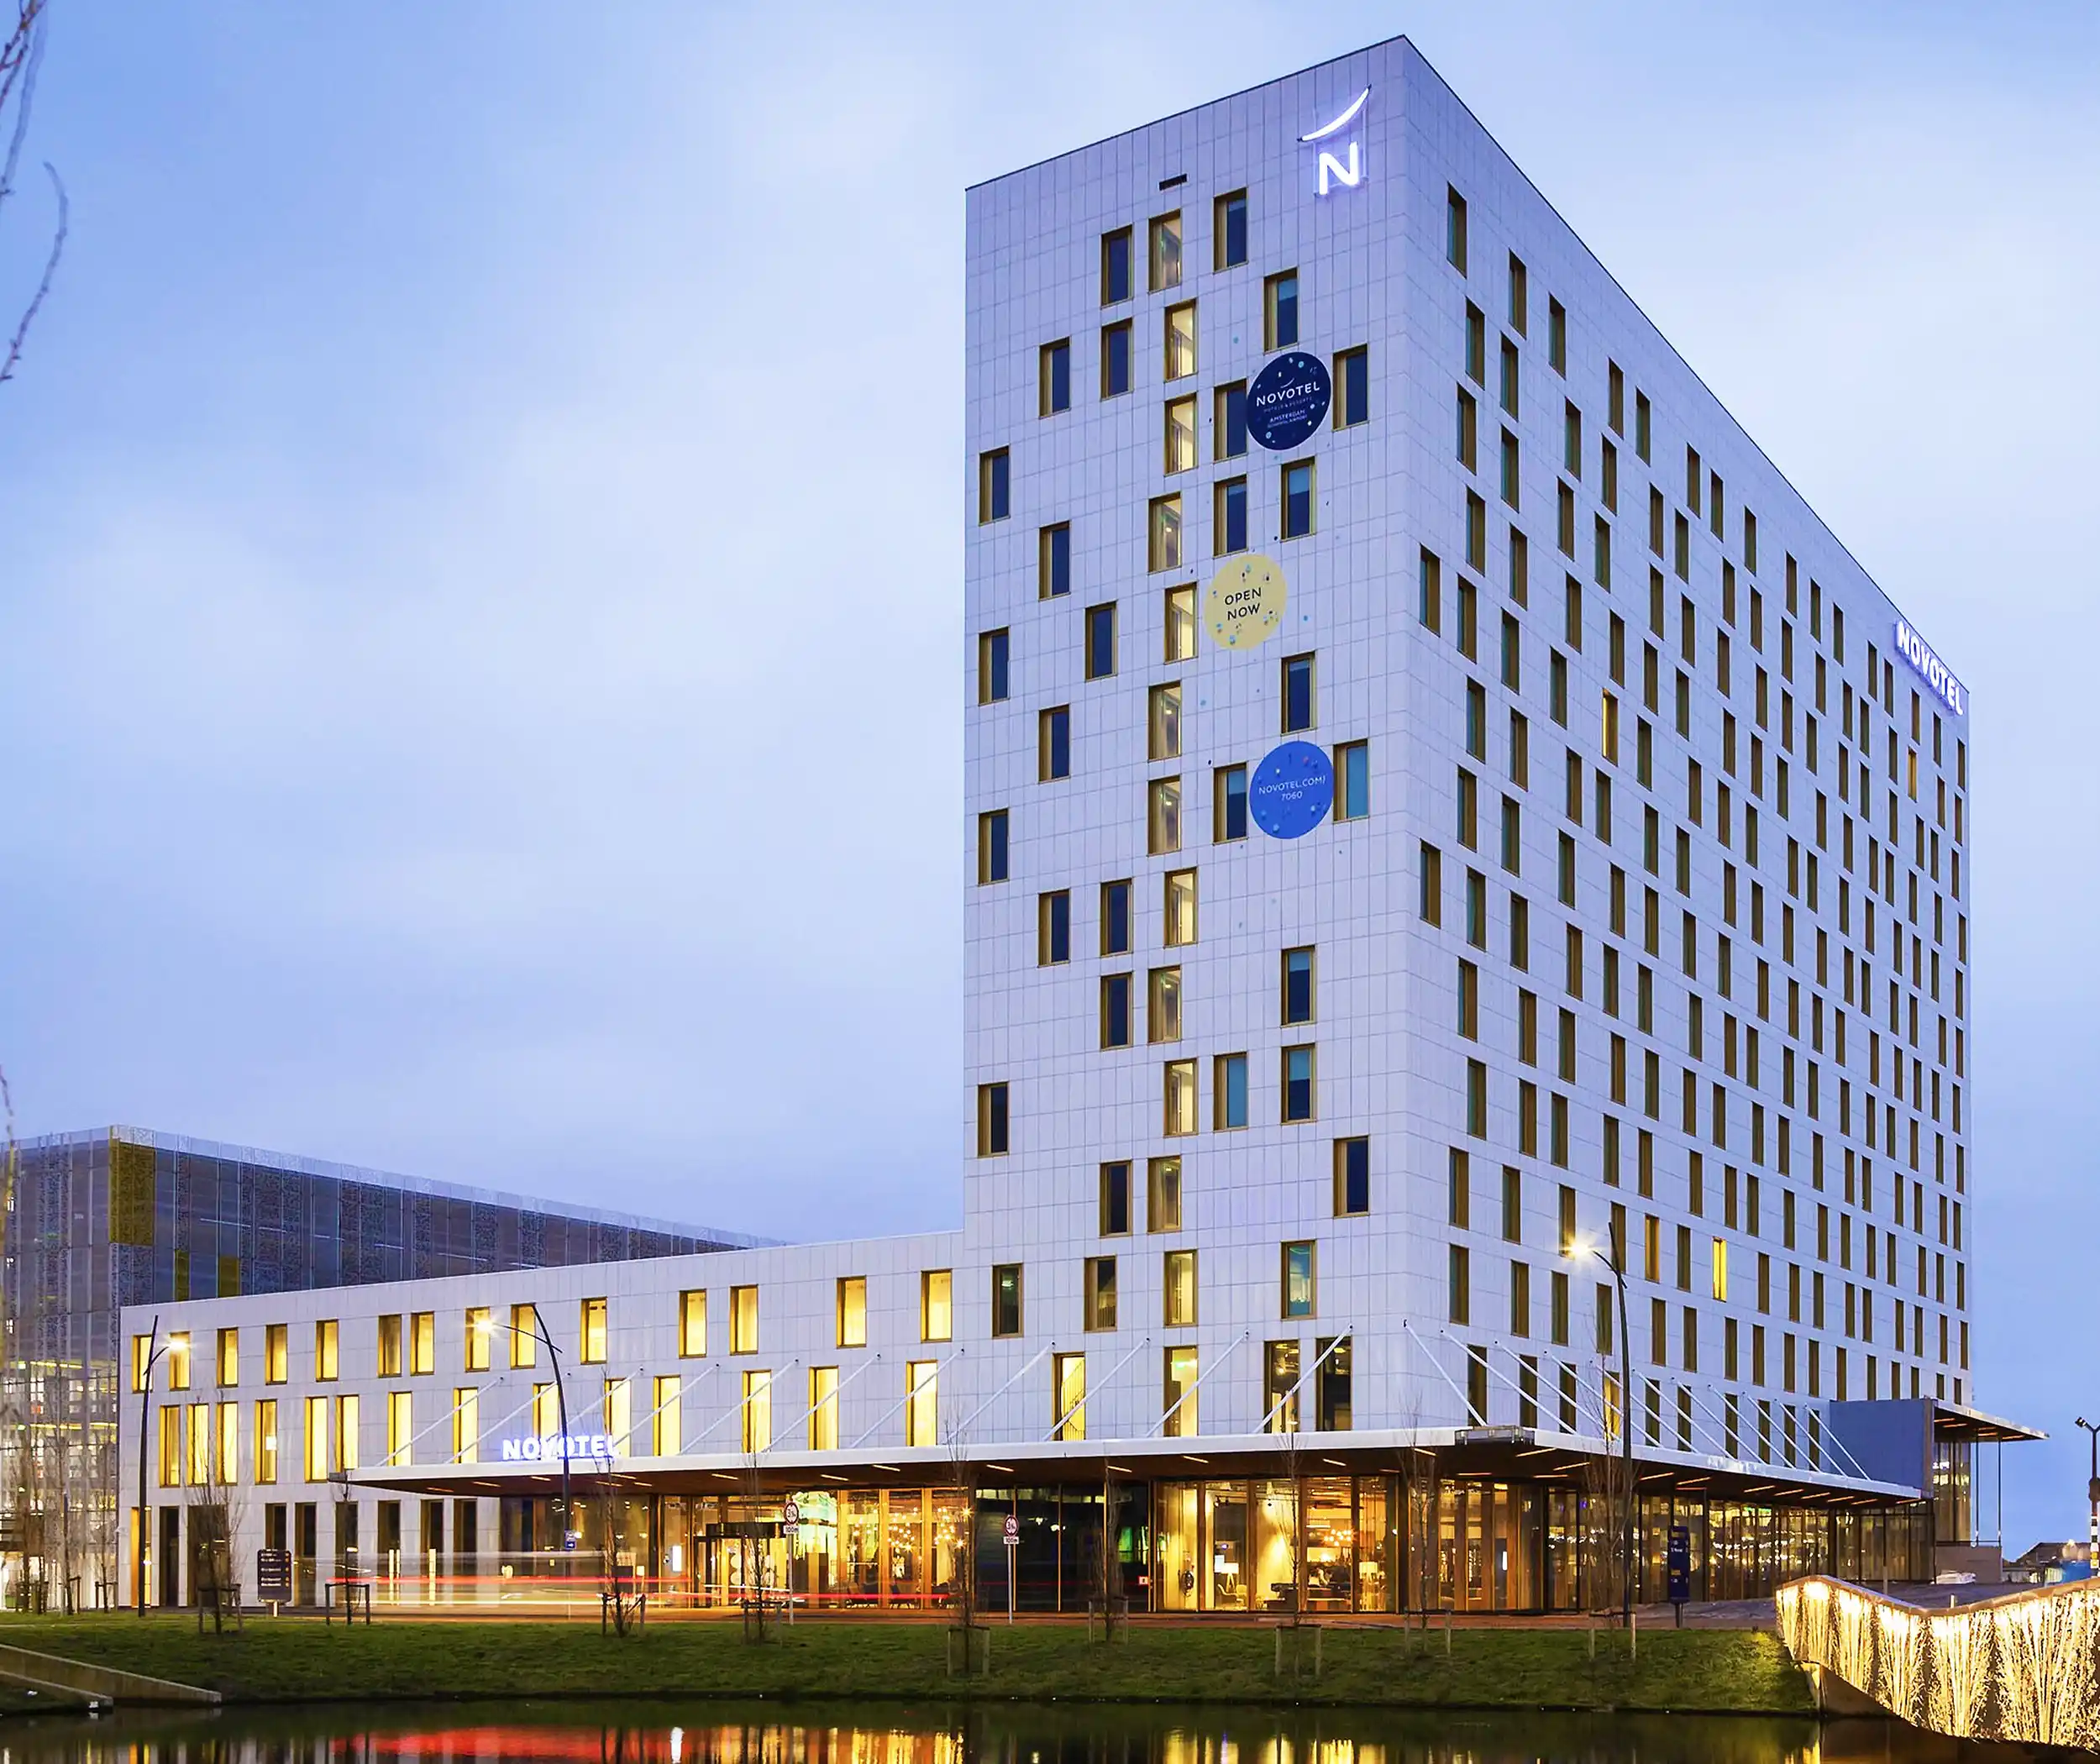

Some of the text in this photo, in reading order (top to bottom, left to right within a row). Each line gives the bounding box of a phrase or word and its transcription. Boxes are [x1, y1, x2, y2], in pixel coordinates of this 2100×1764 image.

[1319, 141, 1359, 195] N
[1256, 381, 1320, 407] NOVOTEL
[1269, 409, 1305, 423] AMSTERDAM
[1224, 587, 1262, 606] OPEN
[1226, 603, 1261, 621] NOW
[1896, 621, 1964, 716] NOVOTEL
[501, 1435, 620, 1461] NOVOTEL
